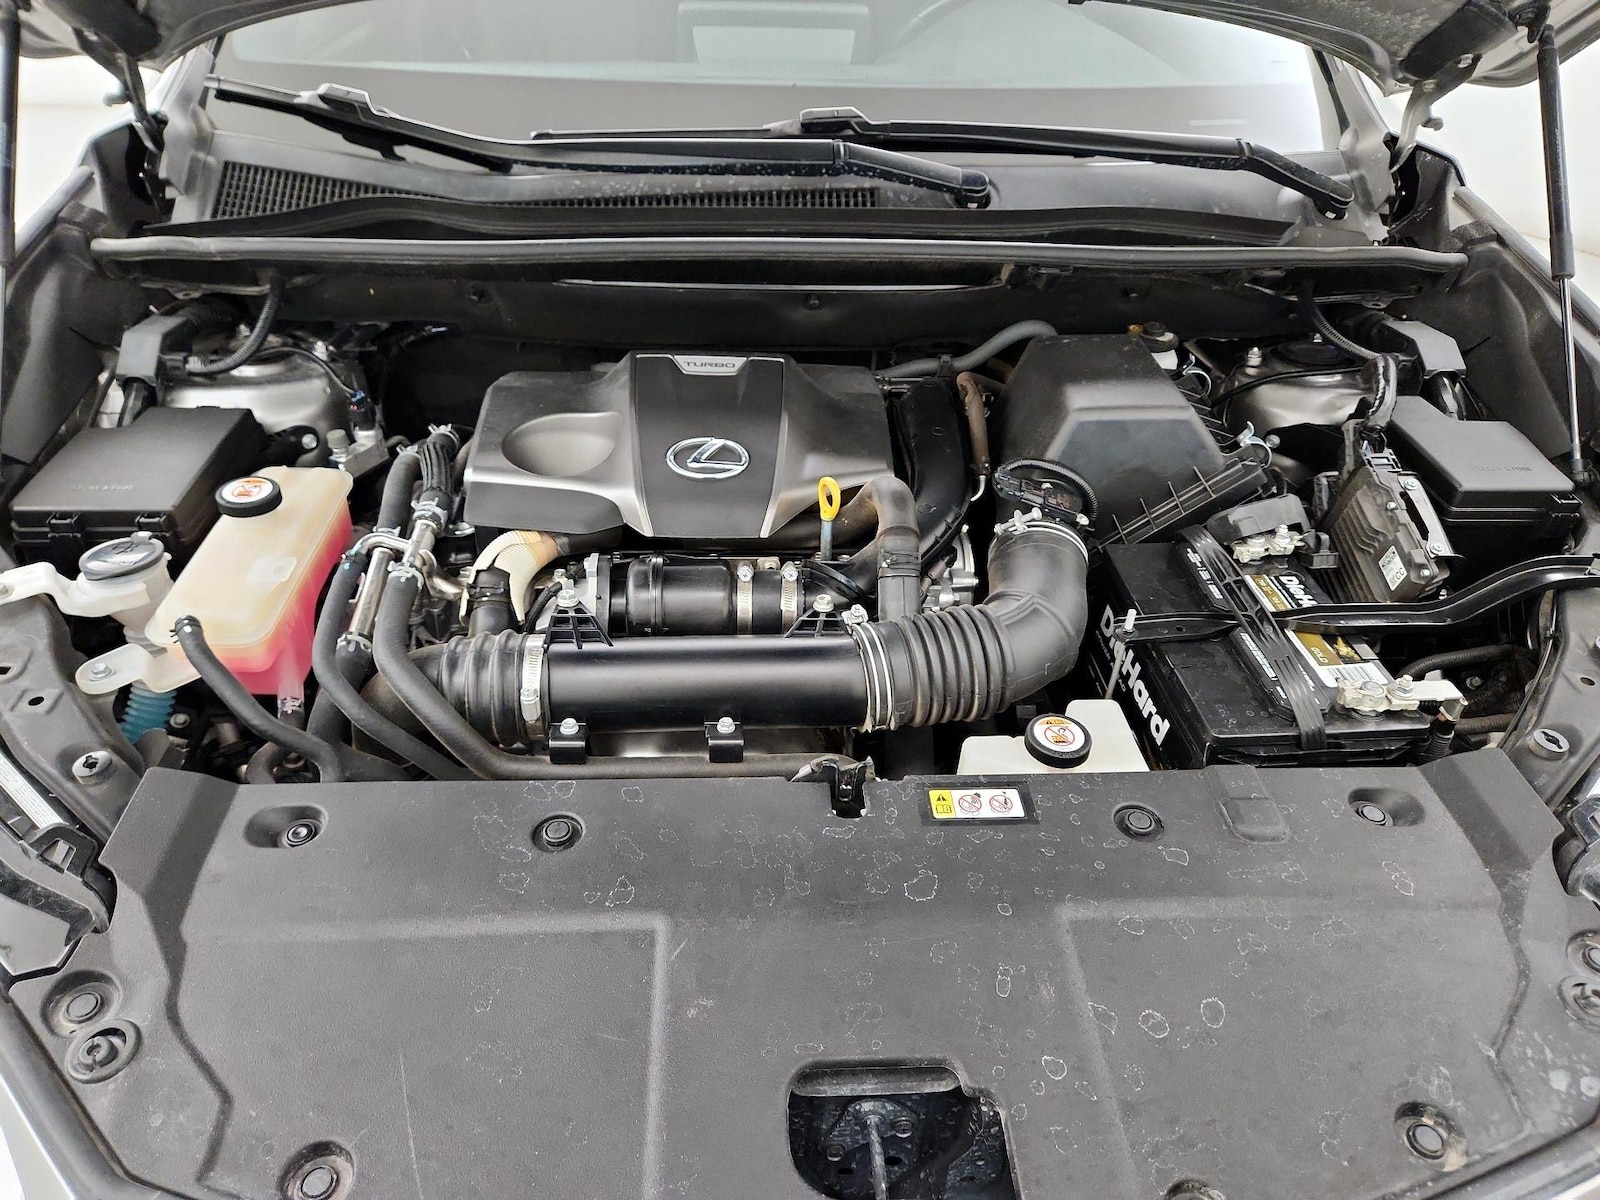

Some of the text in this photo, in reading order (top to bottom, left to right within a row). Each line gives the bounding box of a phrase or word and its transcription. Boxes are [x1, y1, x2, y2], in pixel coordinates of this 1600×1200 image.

[683, 361, 736, 369] TURBO
[1279, 576, 1318, 608] DieH
[1310, 646, 1329, 663] GOLD
